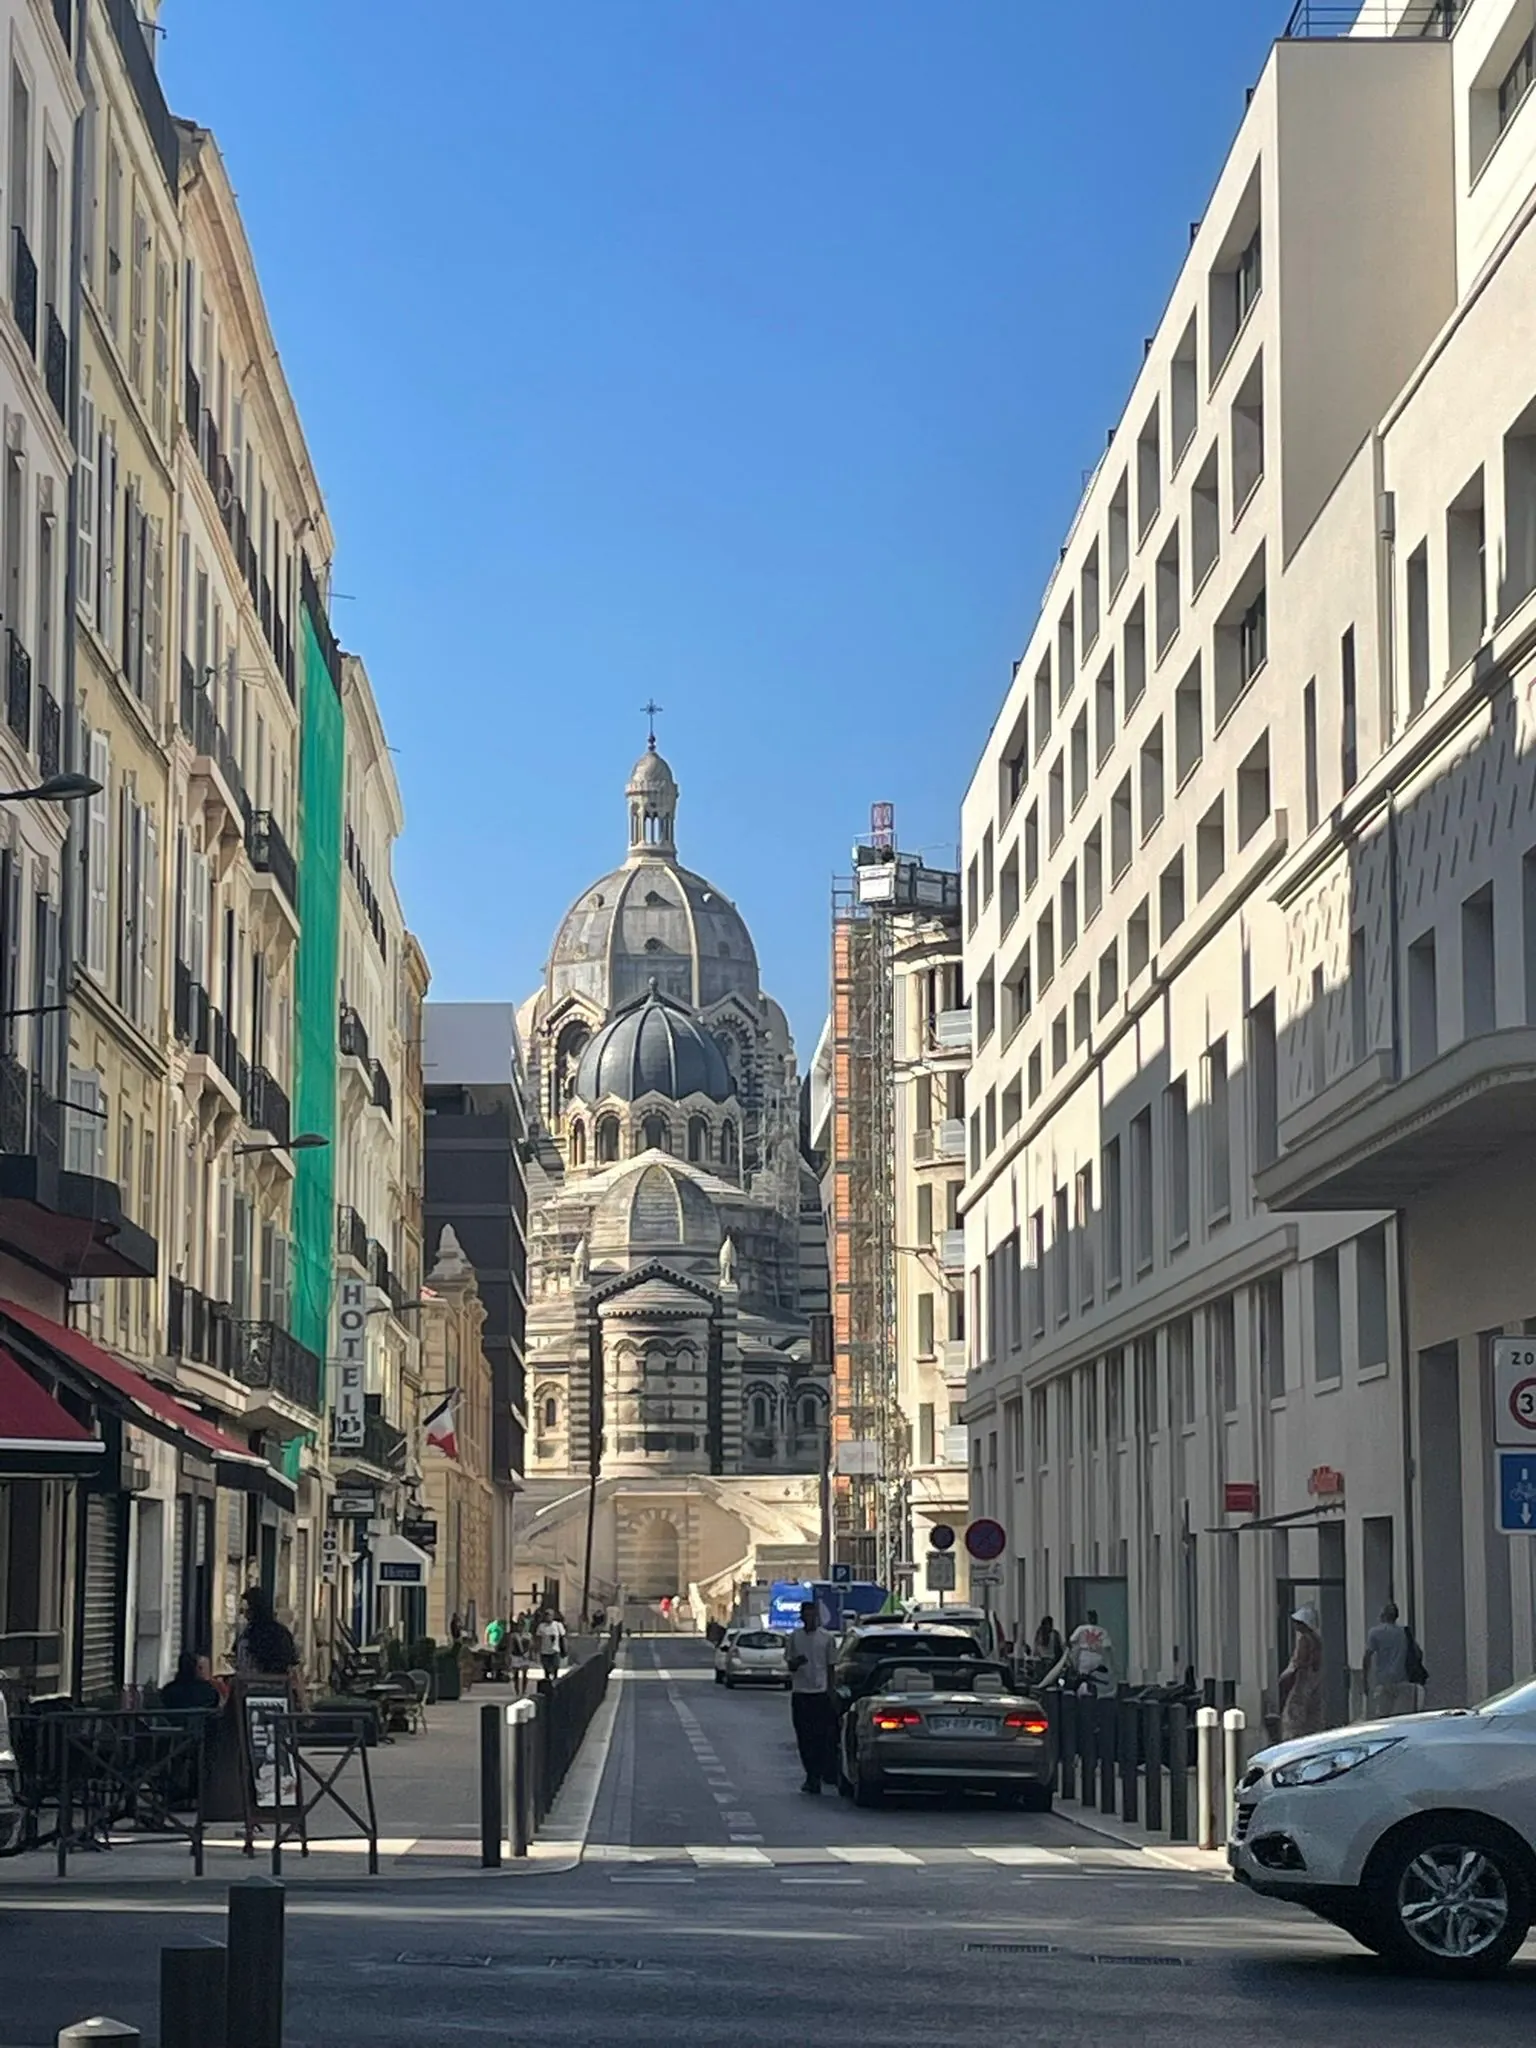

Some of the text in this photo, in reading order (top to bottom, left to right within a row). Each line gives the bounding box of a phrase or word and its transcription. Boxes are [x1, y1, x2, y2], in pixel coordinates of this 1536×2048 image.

[340, 1284, 363, 1415] HOTEL
[1511, 1351, 1535, 1366] ZO
[1520, 1393, 1534, 1414] 3
